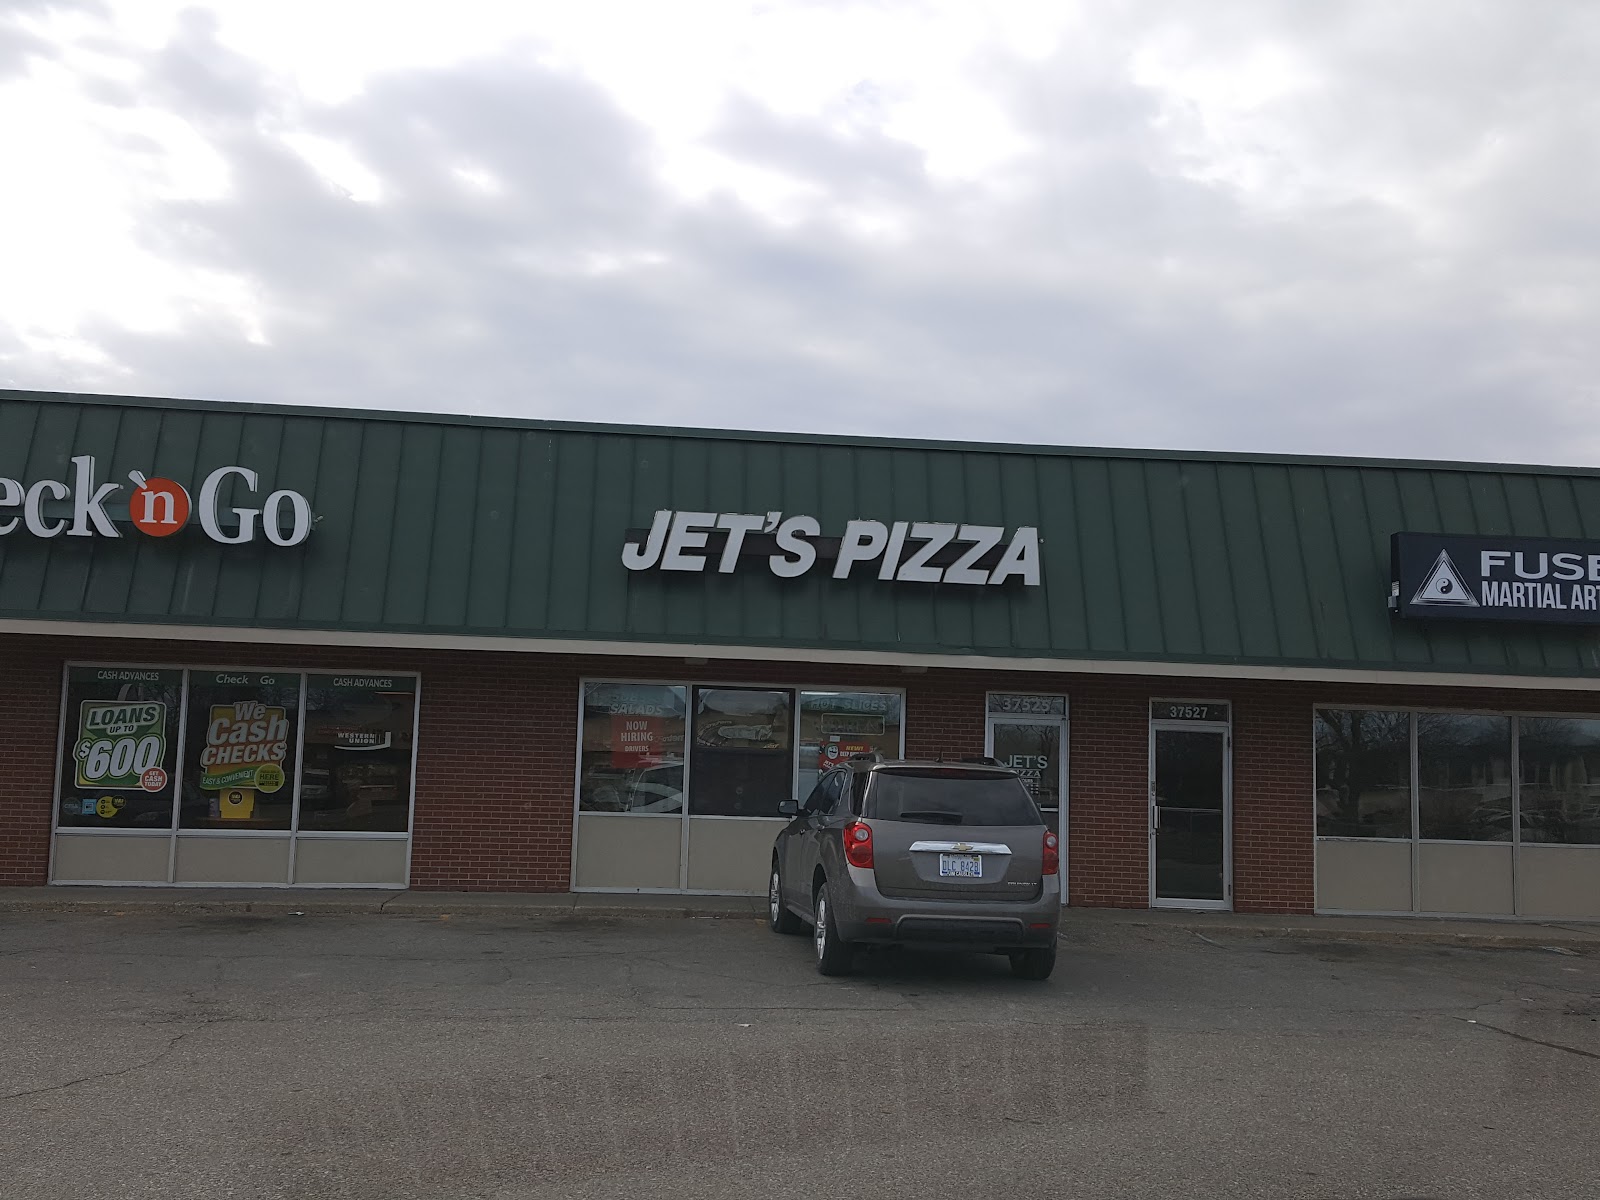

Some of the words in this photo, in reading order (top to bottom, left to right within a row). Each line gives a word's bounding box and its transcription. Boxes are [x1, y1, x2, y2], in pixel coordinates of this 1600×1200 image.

[198, 465, 314, 547] Go
[620, 509, 821, 578] JET'S
[832, 518, 1041, 586] PIZZA
[1482, 581, 1567, 610] MARTIAL
[97, 670, 118, 680] CASH
[119, 671, 159, 681] ADVANCES
[215, 673, 249, 684] Check
[260, 675, 275, 685] Go
[333, 678, 353, 687] CASH
[354, 679, 392, 688] ADVANCES
[234, 702, 266, 721] We
[610, 703, 664, 715] SALADS
[810, 699, 837, 710] HOT
[843, 700, 888, 712] SLICES
[1002, 699, 1050, 711] 37525
[1170, 705, 1208, 719] 37527
[89, 706, 157, 727] LOANS
[109, 726, 122, 734] UP
[123, 725, 134, 733] TO
[208, 714, 288, 746] Cash
[626, 720, 648, 731] NOW
[620, 732, 654, 742] HIRING
[79, 736, 160, 780] $600
[201, 742, 286, 766] CHECKS
[1004, 755, 1048, 769] JET'S
[202, 776, 216, 785] EASY
[221, 769, 255, 784] CONVENIENT
[260, 773, 280, 781] HERE
